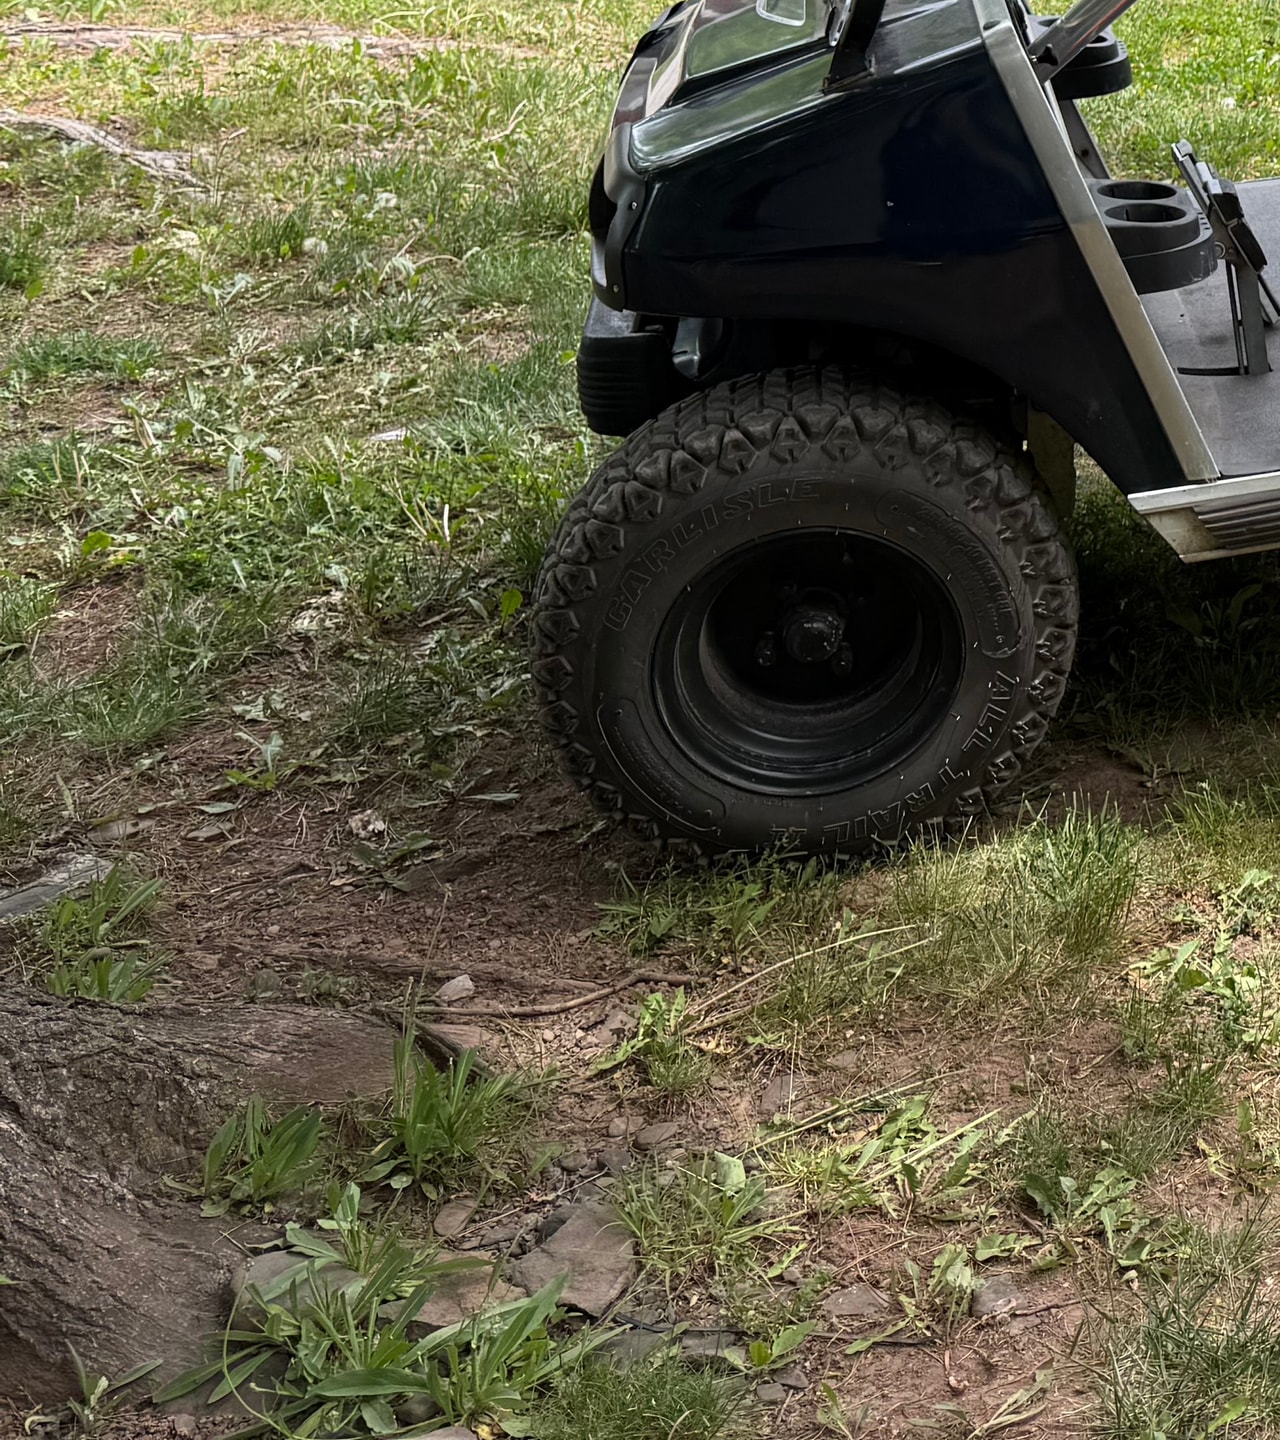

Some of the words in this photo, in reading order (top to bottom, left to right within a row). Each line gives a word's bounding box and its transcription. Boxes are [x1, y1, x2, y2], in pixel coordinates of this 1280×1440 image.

[602, 476, 824, 633] CARLISLE
[961, 670, 1017, 752] ALL
[823, 765, 964, 843] TRAIL
